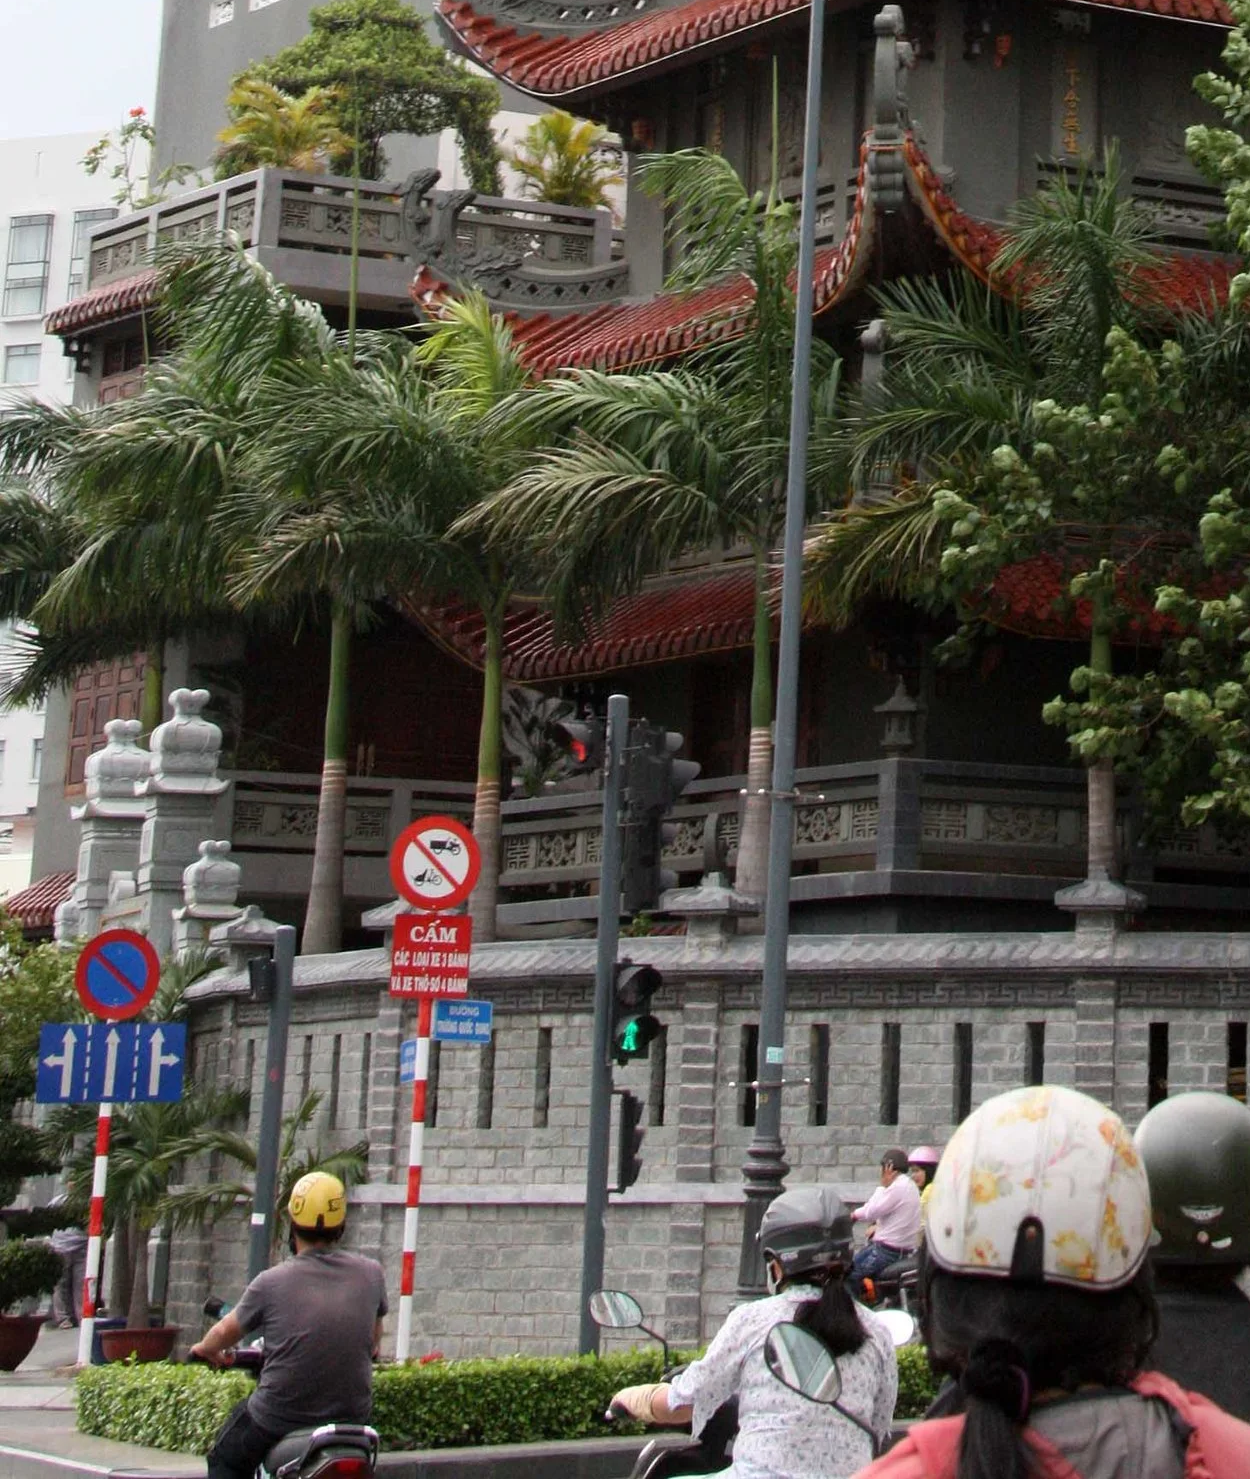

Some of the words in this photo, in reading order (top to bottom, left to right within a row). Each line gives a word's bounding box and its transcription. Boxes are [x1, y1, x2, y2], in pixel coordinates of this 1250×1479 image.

[410, 920, 457, 943] CẤM
[394, 947, 410, 967] CÁC
[430, 951, 441, 967] XE
[442, 952, 448, 968] 3
[402, 976, 413, 991] XE
